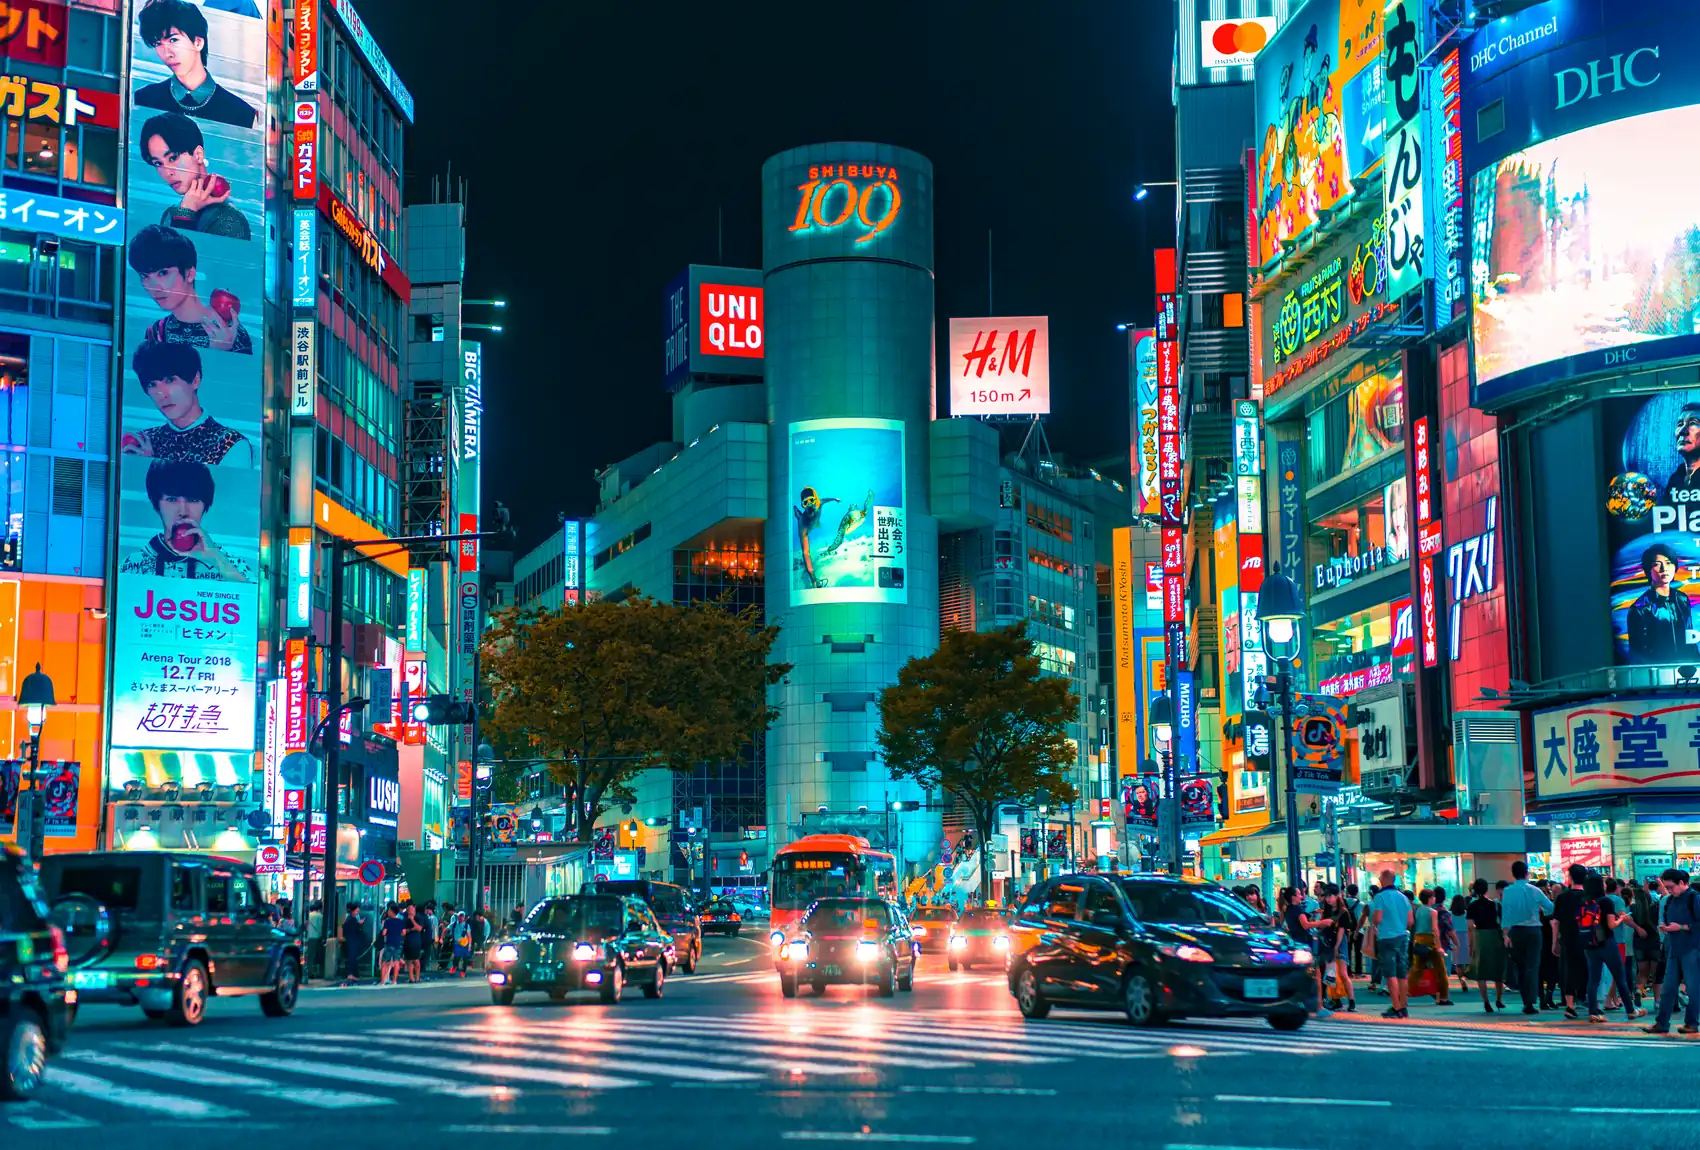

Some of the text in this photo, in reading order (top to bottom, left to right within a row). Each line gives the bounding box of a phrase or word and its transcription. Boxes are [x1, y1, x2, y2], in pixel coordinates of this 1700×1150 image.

[1470, 17, 1558, 73] DHC Channel
[303, 81, 315, 89] 8F
[1554, 45, 1660, 111] DHC
[0, 75, 95, 126] ガスト
[1362, 89, 1386, 116] Shinsen
[1385, 3, 1425, 277] もんじゃ
[298, 143, 312, 189] ガスト
[809, 165, 898, 181] SHIBUYA
[787, 178, 902, 244] 109
[298, 219, 311, 297] 英会話イーオン
[670, 286, 685, 331] THE
[708, 292, 758, 321] UNI
[1303, 276, 1342, 343] 西村
[665, 324, 688, 377] PRIME
[708, 323, 762, 351] QLO
[961, 329, 1037, 378] H&M
[296, 326, 311, 409] 渋谷駅前ビル
[465, 351, 477, 380] BIC
[1604, 348, 1636, 365] DHC
[970, 389, 1014, 404] 150m
[1417, 424, 1429, 520] お好み焼
[877, 516, 903, 528] 世界に
[1242, 556, 1262, 569] JTB
[1315, 541, 1384, 588] Euphoria
[134, 589, 241, 625] Jesus
[196, 591, 241, 601] NEW SINGLE
[463, 609, 475, 654] 調剤薬局
[1121, 604, 1129, 668] Matsumoto
[1244, 609, 1253, 639] パーラー
[140, 652, 232, 667] Arena Tour 2018
[160, 665, 215, 681] 12.7 FRI
[130, 681, 239, 696] さいたまスーパーアリーナ
[1343, 675, 1365, 692] 海外旅行
[137, 702, 230, 734] 超特急
[1180, 682, 1191, 729] MIZUHO
[408, 730, 418, 738] 3F
[1304, 771, 1315, 779] Tik
[370, 776, 399, 814] LUSH
